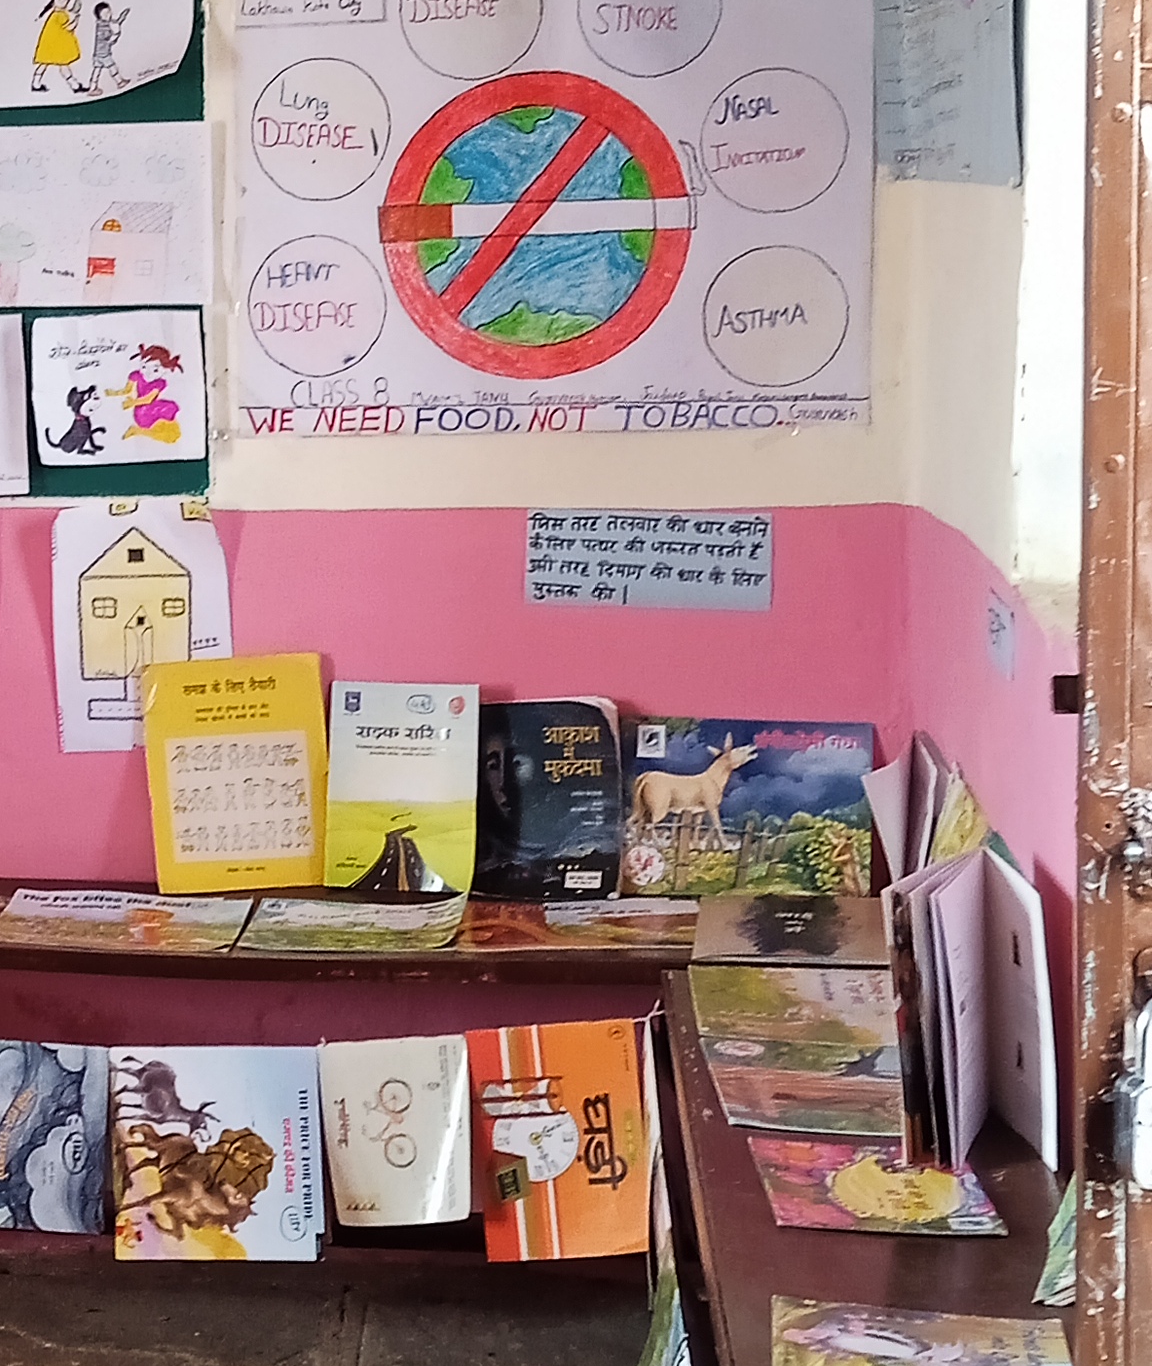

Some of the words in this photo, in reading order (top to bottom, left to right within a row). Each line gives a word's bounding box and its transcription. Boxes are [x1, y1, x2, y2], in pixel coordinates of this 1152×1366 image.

[280, 79, 329, 121] Lung
[714, 94, 779, 125] NASAL
[258, 117, 364, 149] DISEASE
[253, 301, 358, 332] DISEASE
[712, 301, 808, 337] ASTHMA
[290, 380, 359, 407] CLASS
[373, 376, 390, 407] 8
[248, 407, 294, 434] WE
[313, 406, 405, 434] NEED
[414, 406, 521, 434] FOOD,
[527, 404, 597, 433] NOT
[607, 515, 661, 534] तलवार
[666, 514, 689, 533] की
[624, 536, 646, 553] की
[597, 559, 647, 581] दिमाग
[650, 562, 675, 580] की
[708, 566, 727, 585] के
[577, 1092, 630, 1191] घड़ी
